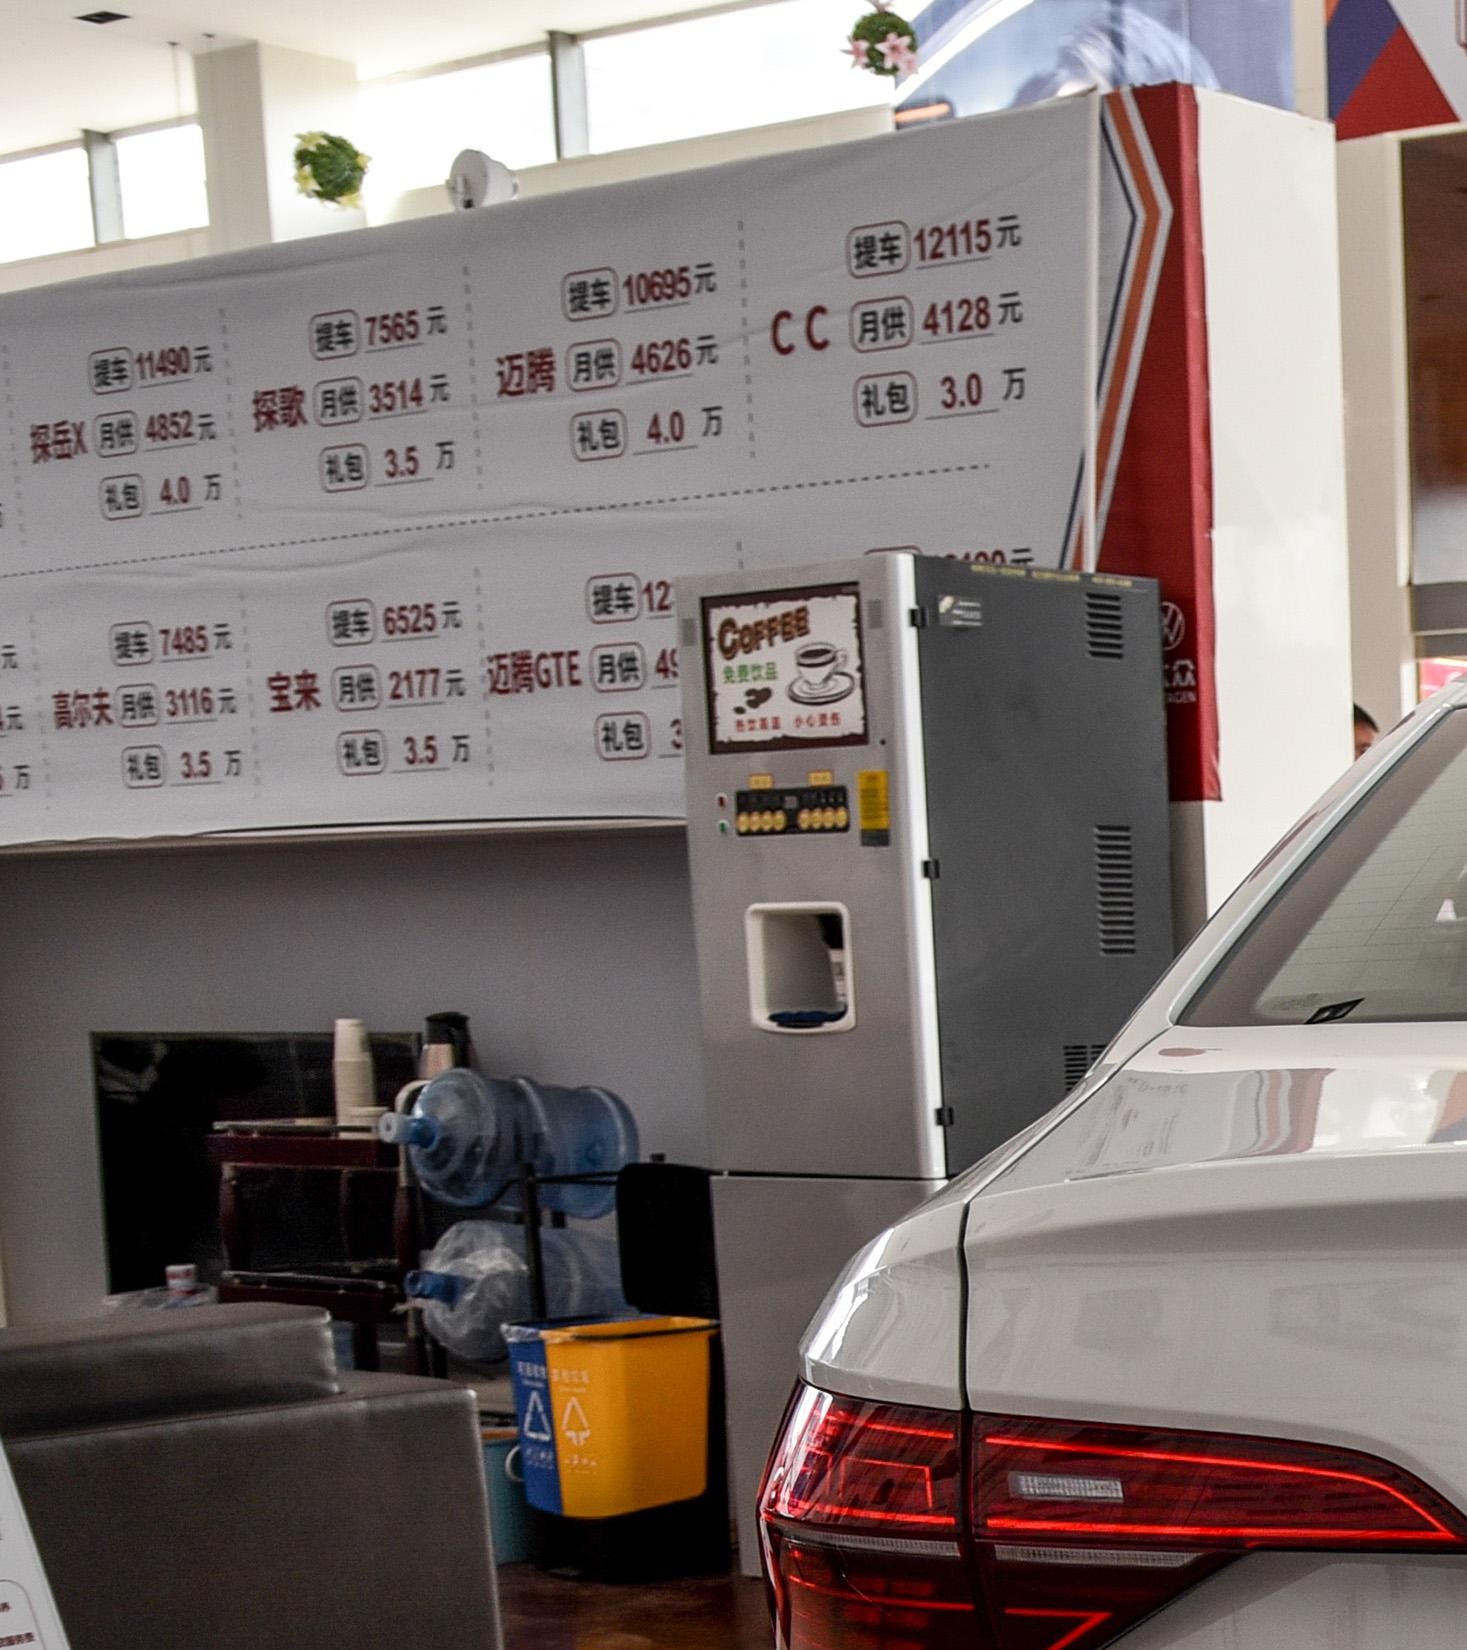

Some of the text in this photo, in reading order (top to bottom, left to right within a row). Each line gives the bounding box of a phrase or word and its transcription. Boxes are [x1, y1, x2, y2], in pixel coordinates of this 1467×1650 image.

[854, 231, 903, 270] 提车
[569, 278, 611, 314] 提车
[315, 319, 354, 353] 提车
[858, 305, 906, 344] 月供
[496, 346, 556, 398] 迈腾
[573, 347, 616, 383] 月供
[321, 385, 358, 418] 月供
[861, 381, 911, 418] 礼包
[577, 418, 621, 452] 礼包
[325, 452, 364, 485] 礼包
[592, 582, 634, 616] 提车
[332, 608, 370, 639] 提车
[718, 605, 811, 661] COFFEE
[598, 650, 639, 684] 月供
[267, 669, 322, 713] 宝来
[339, 673, 376, 703] 月供
[52, 686, 114, 731] 高尔夫
[343, 737, 381, 768] 礼包
[601, 720, 644, 752] 礼包
